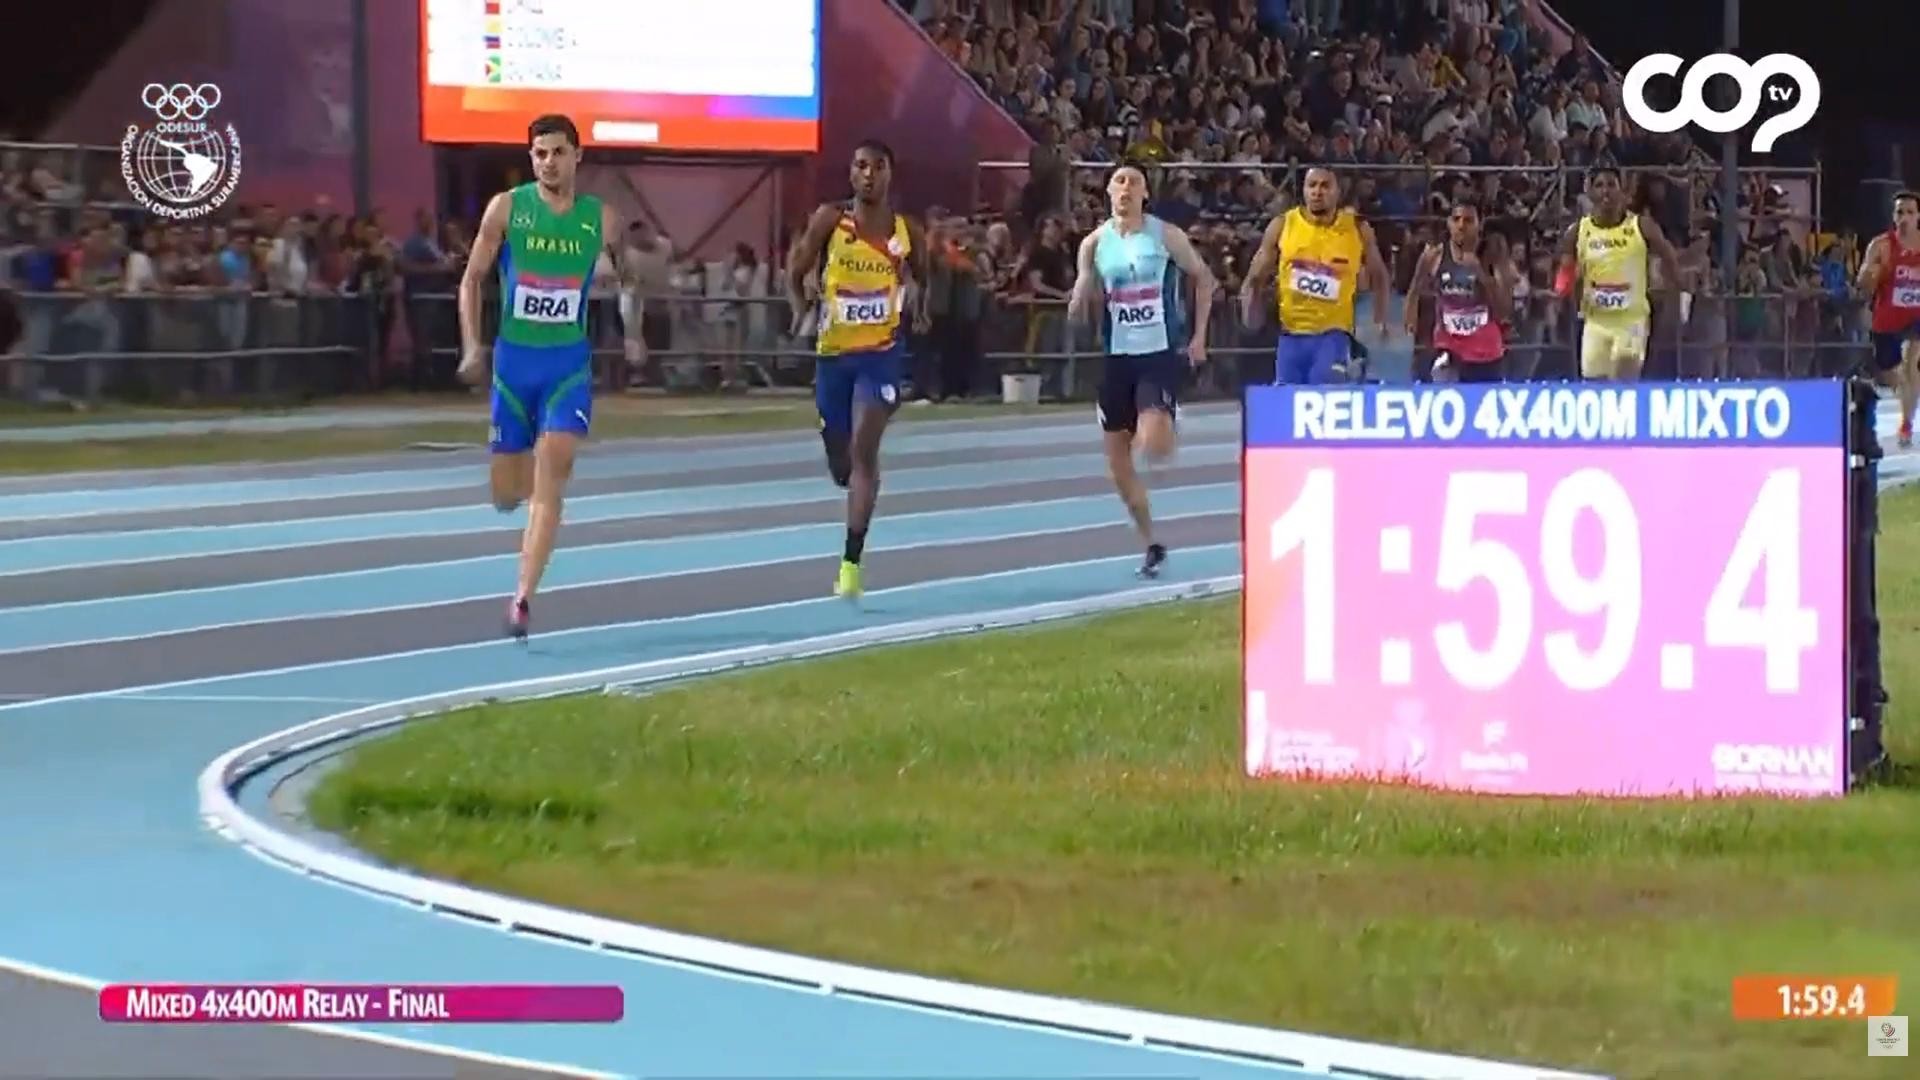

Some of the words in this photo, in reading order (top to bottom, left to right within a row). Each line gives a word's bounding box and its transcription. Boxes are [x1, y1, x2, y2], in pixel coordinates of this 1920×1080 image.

[526, 236, 582, 255] BRASIL
[1297, 276, 1330, 297] COL
[523, 295, 569, 318] BRA
[846, 303, 884, 321] ECU
[1118, 305, 1154, 324] ARG
[1293, 389, 1465, 440] RELEVO
[1473, 388, 1637, 439] 4X400M
[1650, 387, 1790, 439] MIXTO
[1270, 466, 1819, 694] 1:59.4
[1712, 743, 1835, 776] BORNAN
